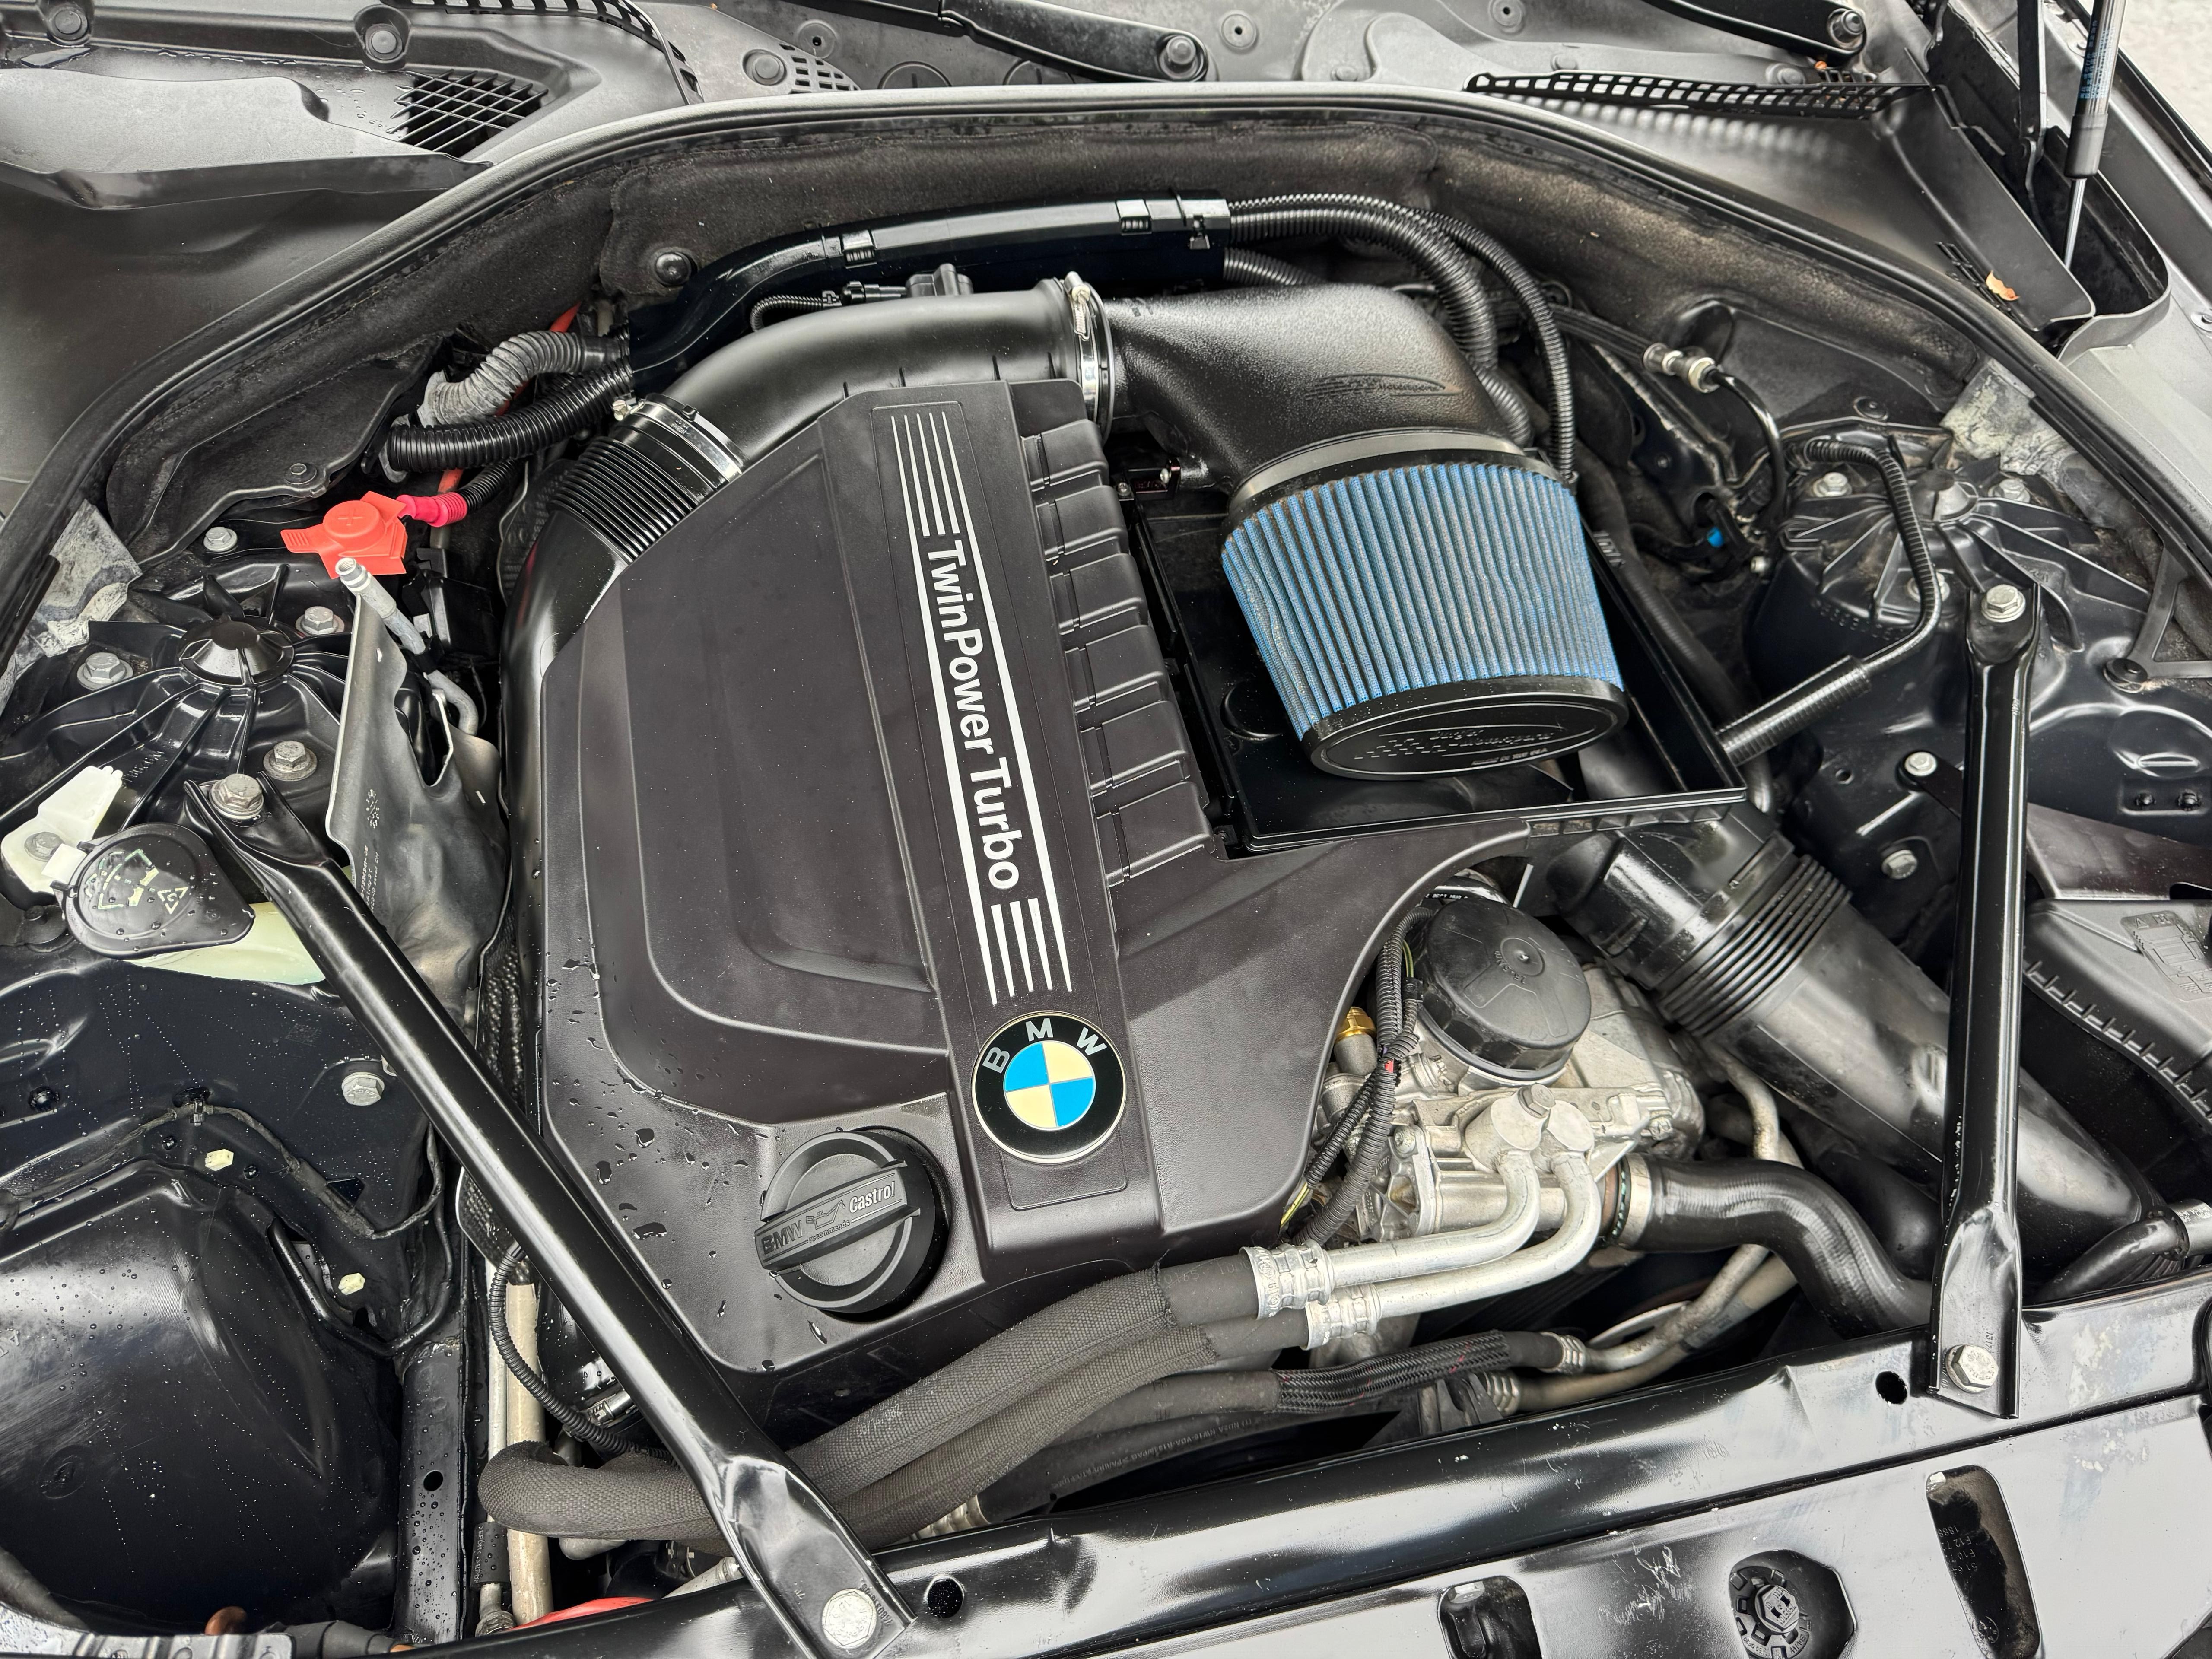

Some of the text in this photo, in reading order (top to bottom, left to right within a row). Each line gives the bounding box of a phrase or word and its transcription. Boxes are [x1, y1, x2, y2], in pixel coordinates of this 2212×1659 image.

[927, 539, 1021, 890] TwinPower Turbo
[982, 1017, 1107, 1074] BMW
[761, 1180, 895, 1255] BMW Castrol
[808, 1219, 850, 1243] recommends
